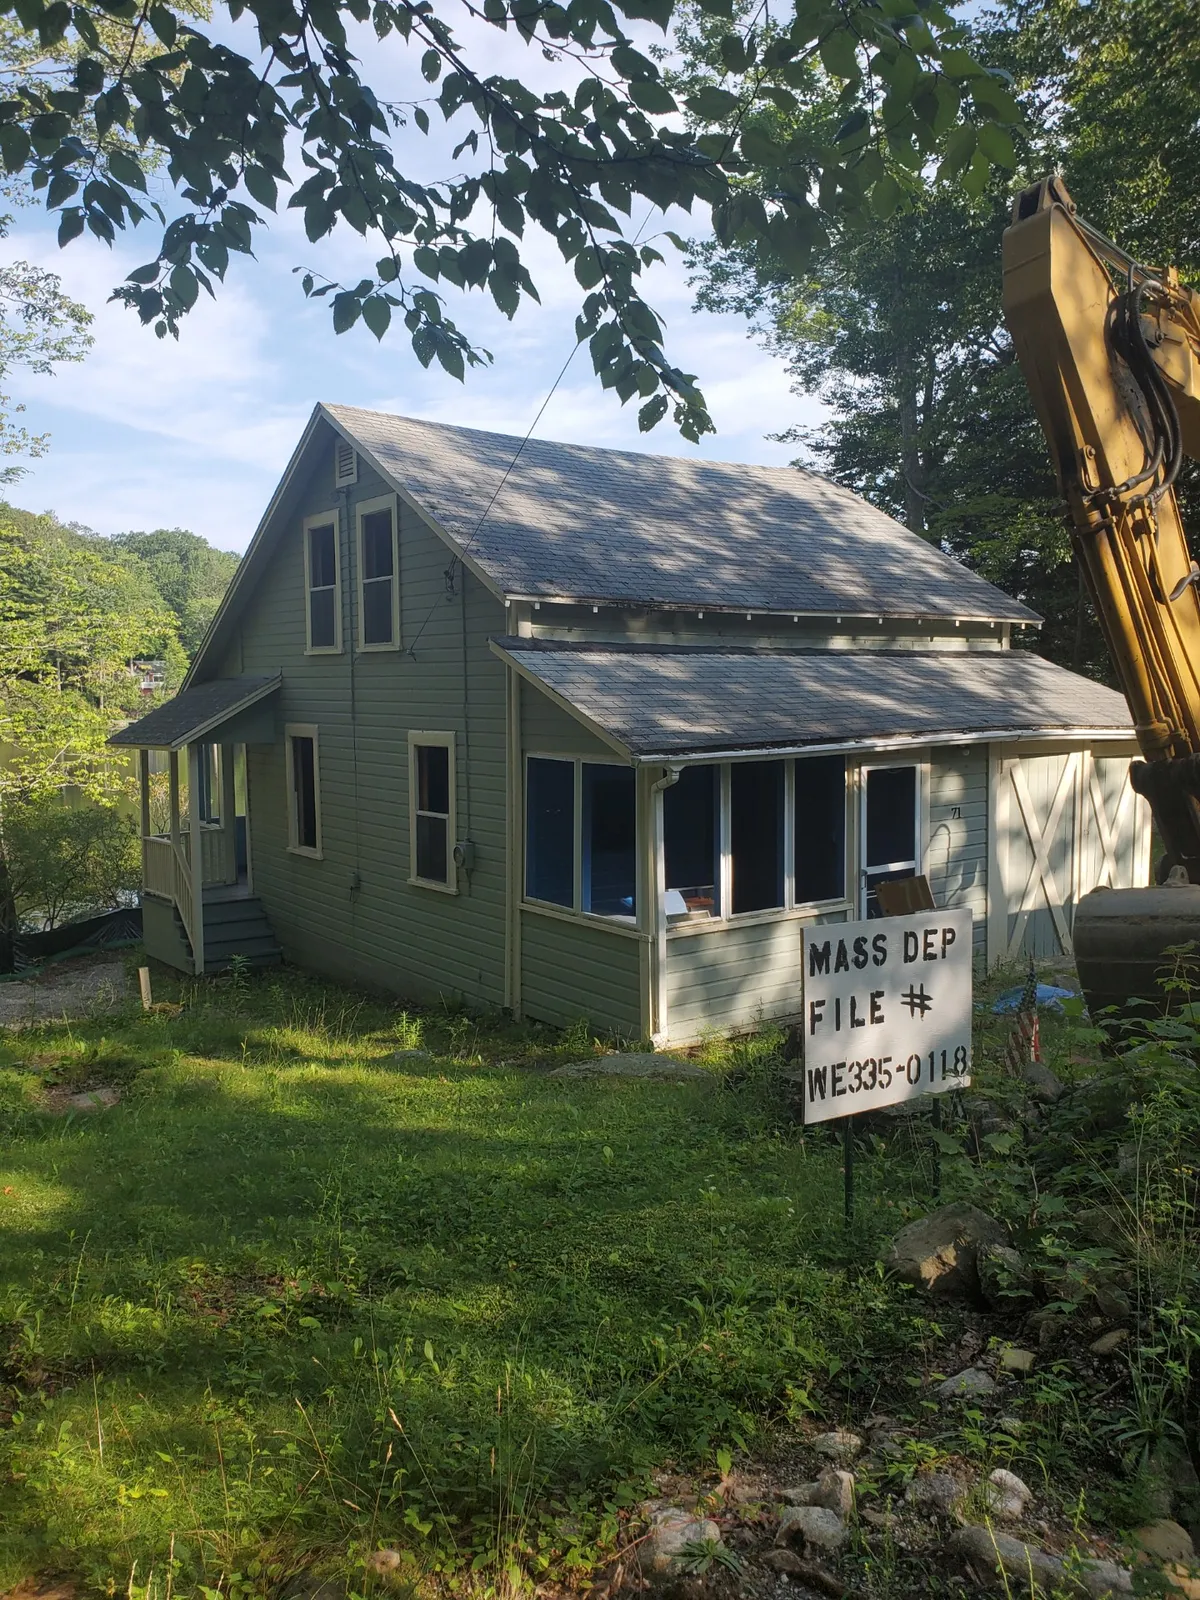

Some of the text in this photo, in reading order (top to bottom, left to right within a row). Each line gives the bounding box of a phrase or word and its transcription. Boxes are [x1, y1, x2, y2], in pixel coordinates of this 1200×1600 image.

[951, 807, 961, 819] 71
[809, 927, 956, 977] MASS DEP
[810, 983, 933, 1035] FILE #
[808, 1045, 967, 1102] WE335-0118
